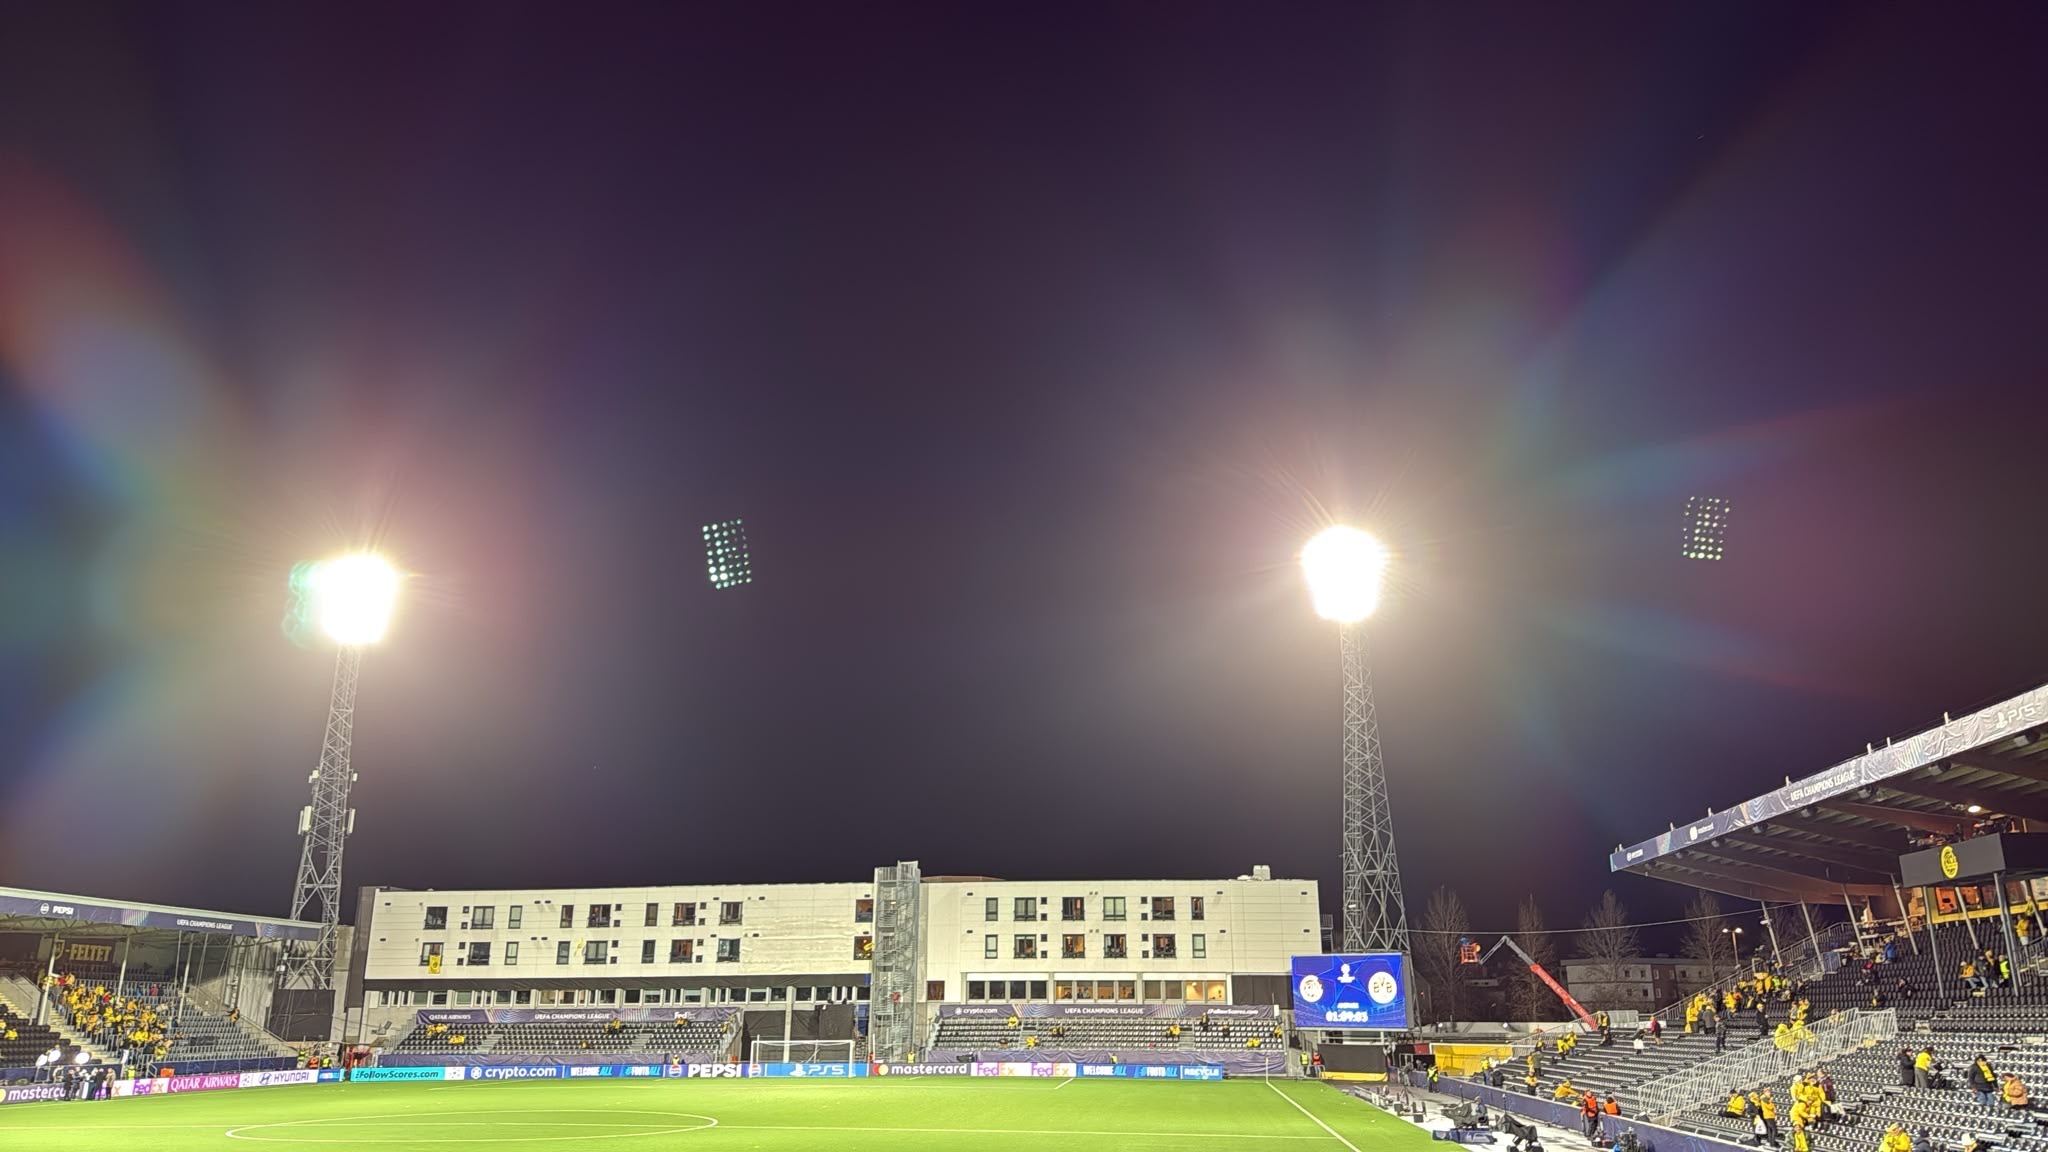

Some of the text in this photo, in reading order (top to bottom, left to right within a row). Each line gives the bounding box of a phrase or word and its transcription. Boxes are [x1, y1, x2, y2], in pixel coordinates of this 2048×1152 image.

[1791, 768, 1856, 801] UEFA CHAMPIONS LEAGUE
[53, 905, 74, 915] PEPSI
[190, 921, 216, 929] CHAMPIONS
[216, 922, 233, 930] LEAGUE
[485, 1066, 556, 1079] crypto.com
[571, 1066, 600, 1076] WELCOME
[688, 1064, 741, 1078] PEPSI
[808, 1065, 846, 1075] PS5
[891, 1064, 967, 1075] mastercard
[976, 1063, 1016, 1076] FedEx
[1031, 1063, 1070, 1076] FedEx
[1083, 1066, 1113, 1076] WELCOME
[274, 1071, 309, 1082] HYUNDAI
[133, 1080, 163, 1095] FedEx
[171, 1075, 238, 1092] QATAR AIRWAYS
